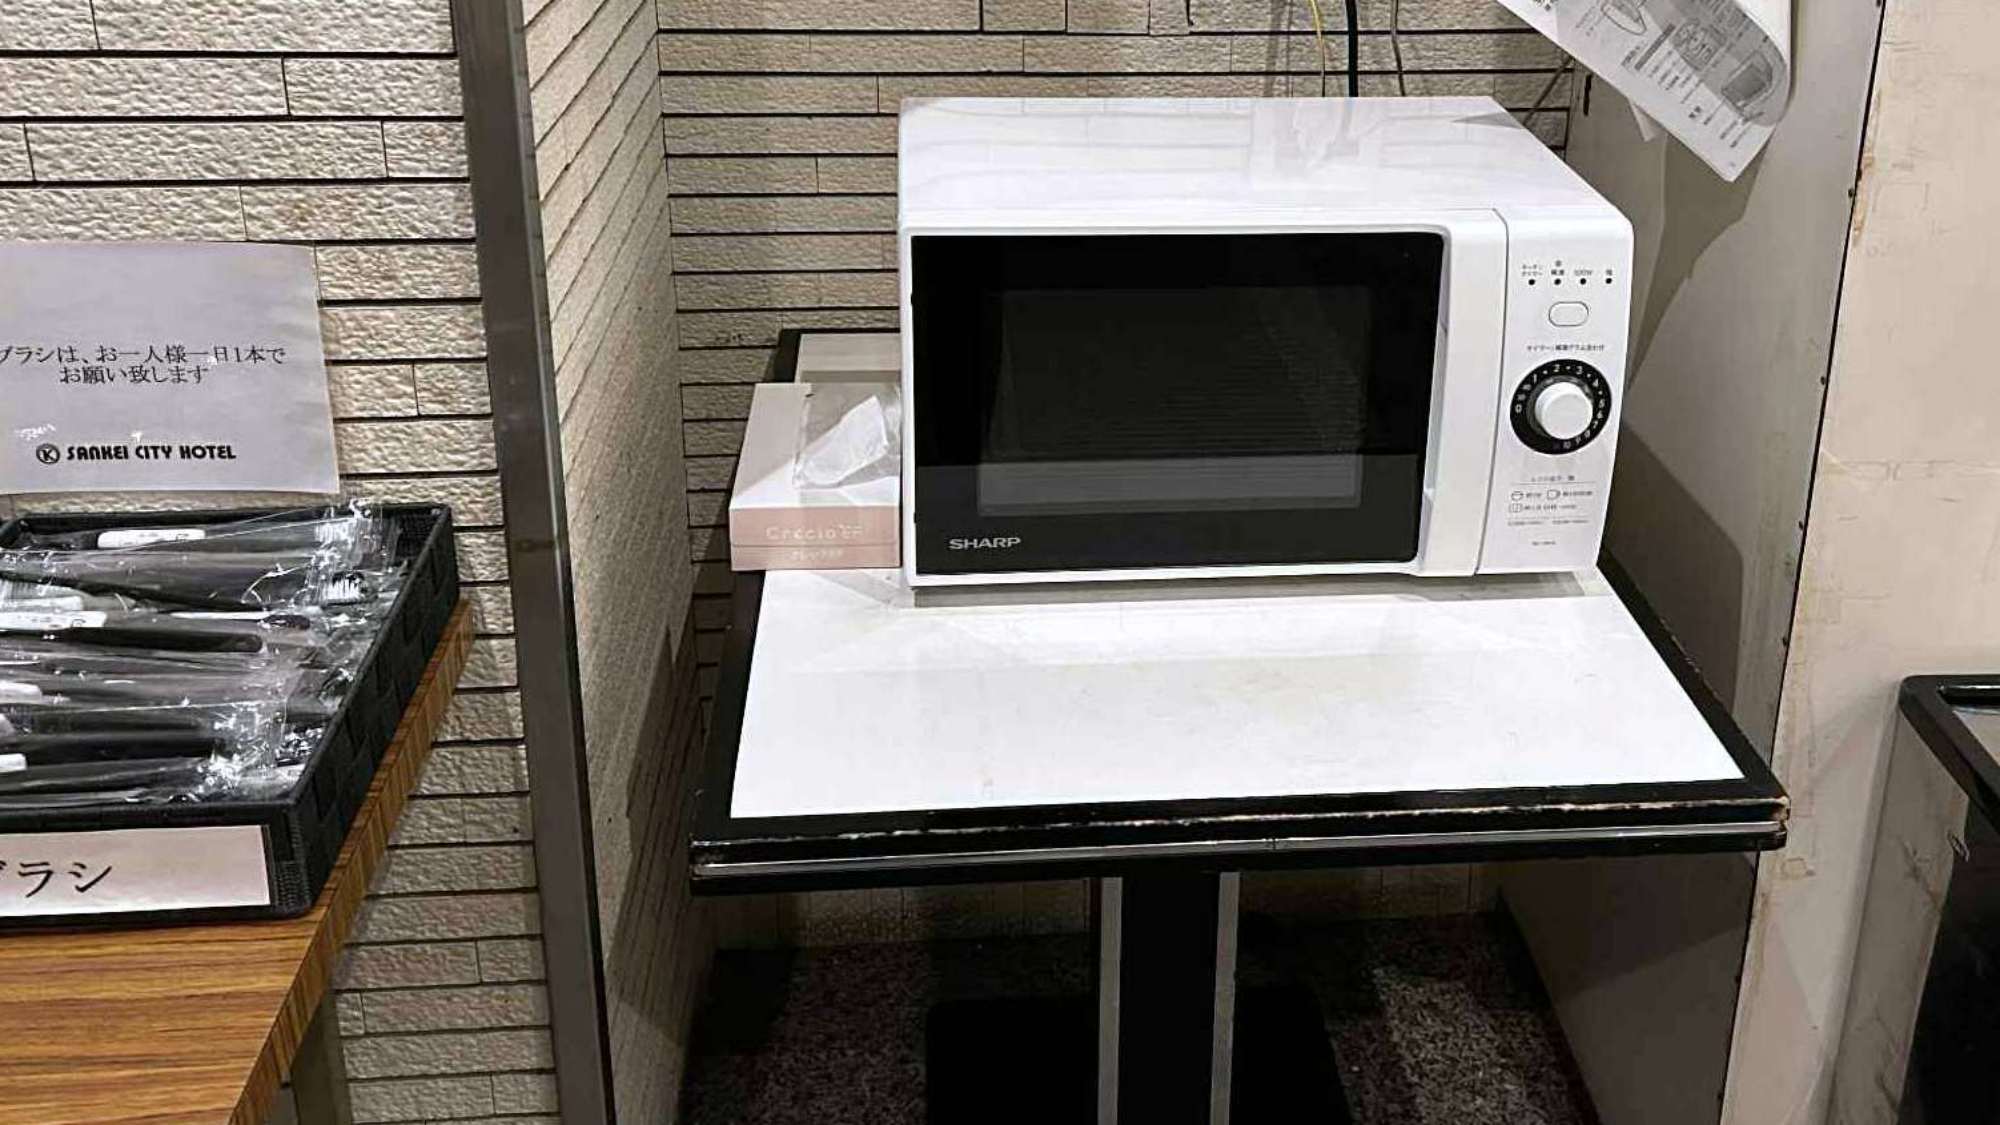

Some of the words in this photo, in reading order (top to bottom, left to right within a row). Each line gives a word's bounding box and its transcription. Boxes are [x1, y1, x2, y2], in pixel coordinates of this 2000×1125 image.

[60, 365, 208, 384] お願い致します
[1553, 364, 1561, 373] 2
[1576, 365, 1583, 375] 3
[67, 445, 129, 460] SANKEI
[135, 445, 172, 460] CITY
[179, 445, 237, 460] HOTEL
[949, 537, 1021, 550] SHARP
[0, 860, 113, 898] ラシ
